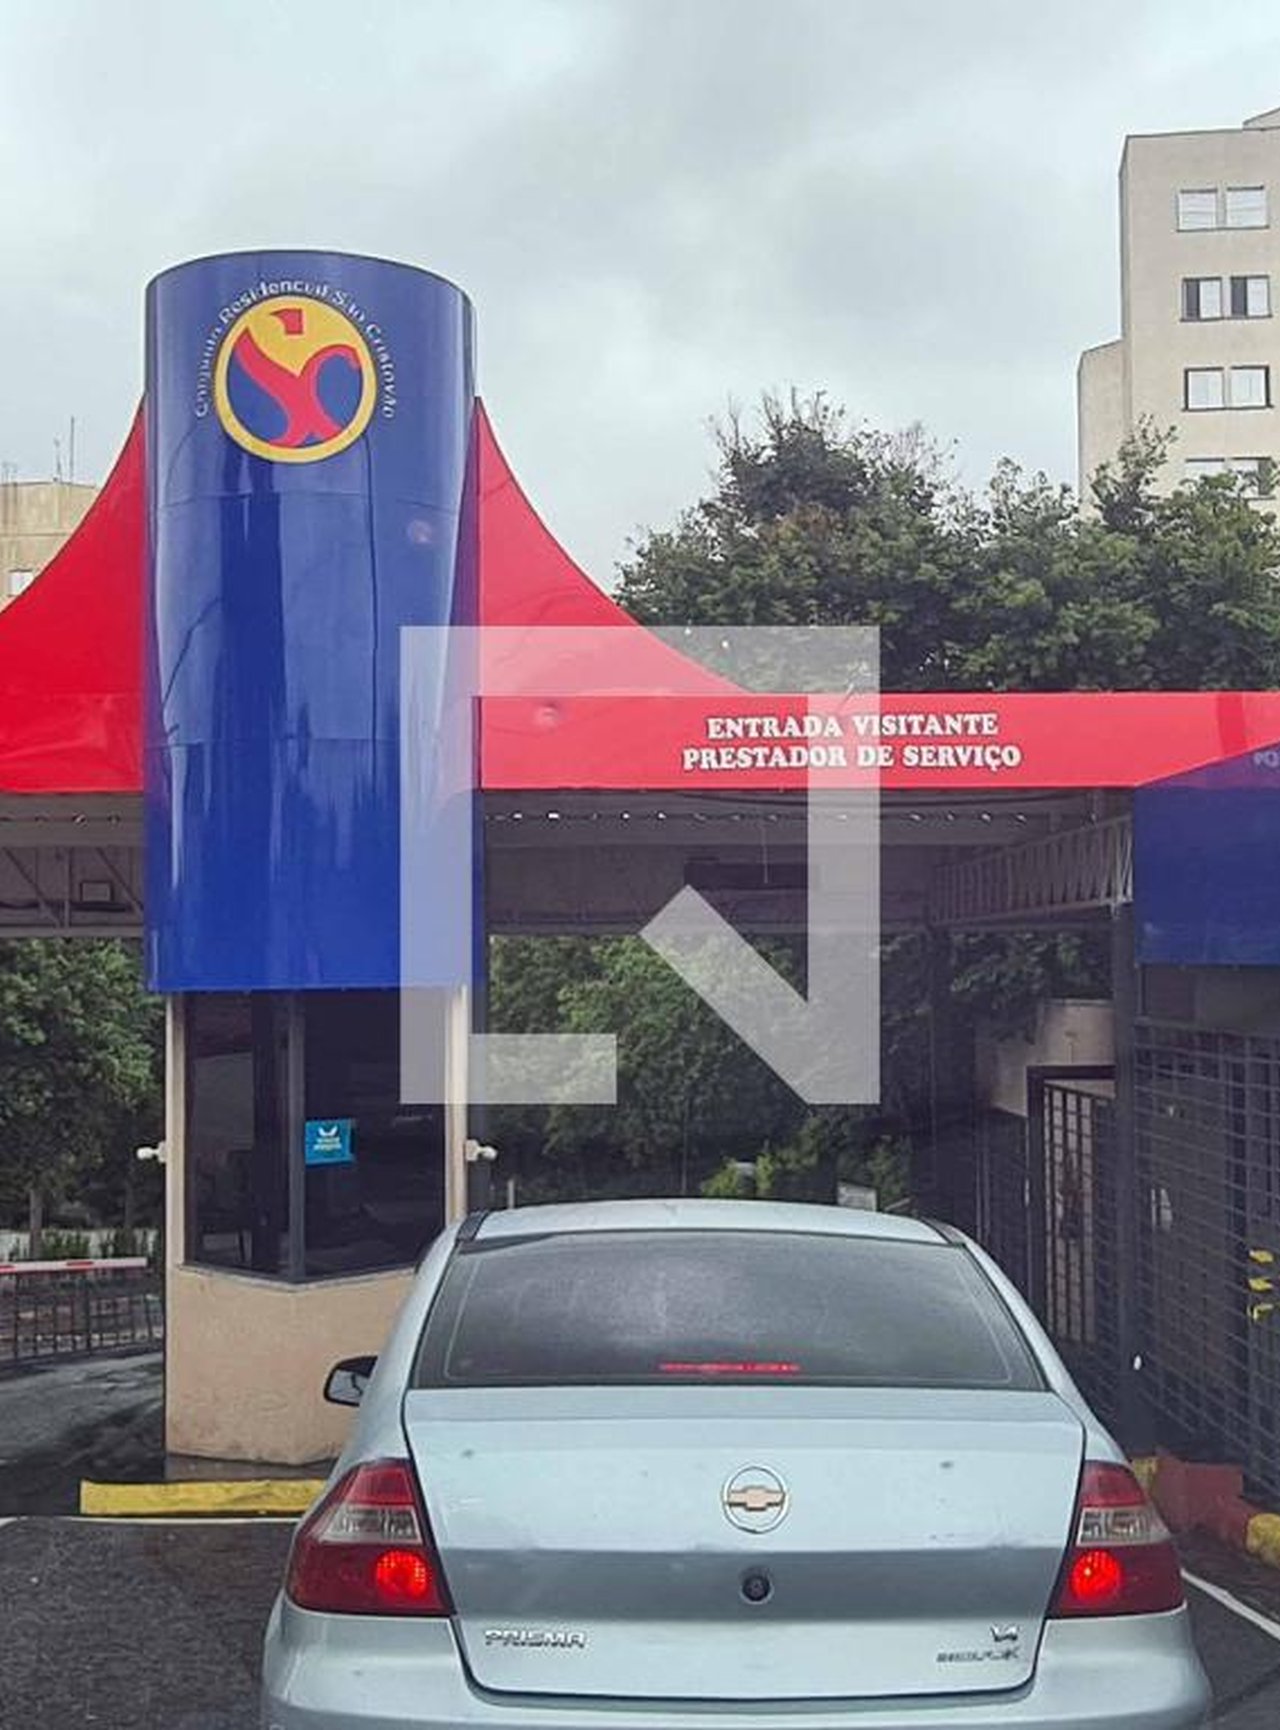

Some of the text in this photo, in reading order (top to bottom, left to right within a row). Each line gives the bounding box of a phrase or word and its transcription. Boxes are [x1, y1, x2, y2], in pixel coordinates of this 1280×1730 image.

[219, 280, 329, 324] Residencial
[706, 713, 999, 739] ENTRADA VISITANTE
[683, 745, 1021, 771] PRESTADOR DE SERVIÇO
[485, 1629, 585, 1648] PRISMA
